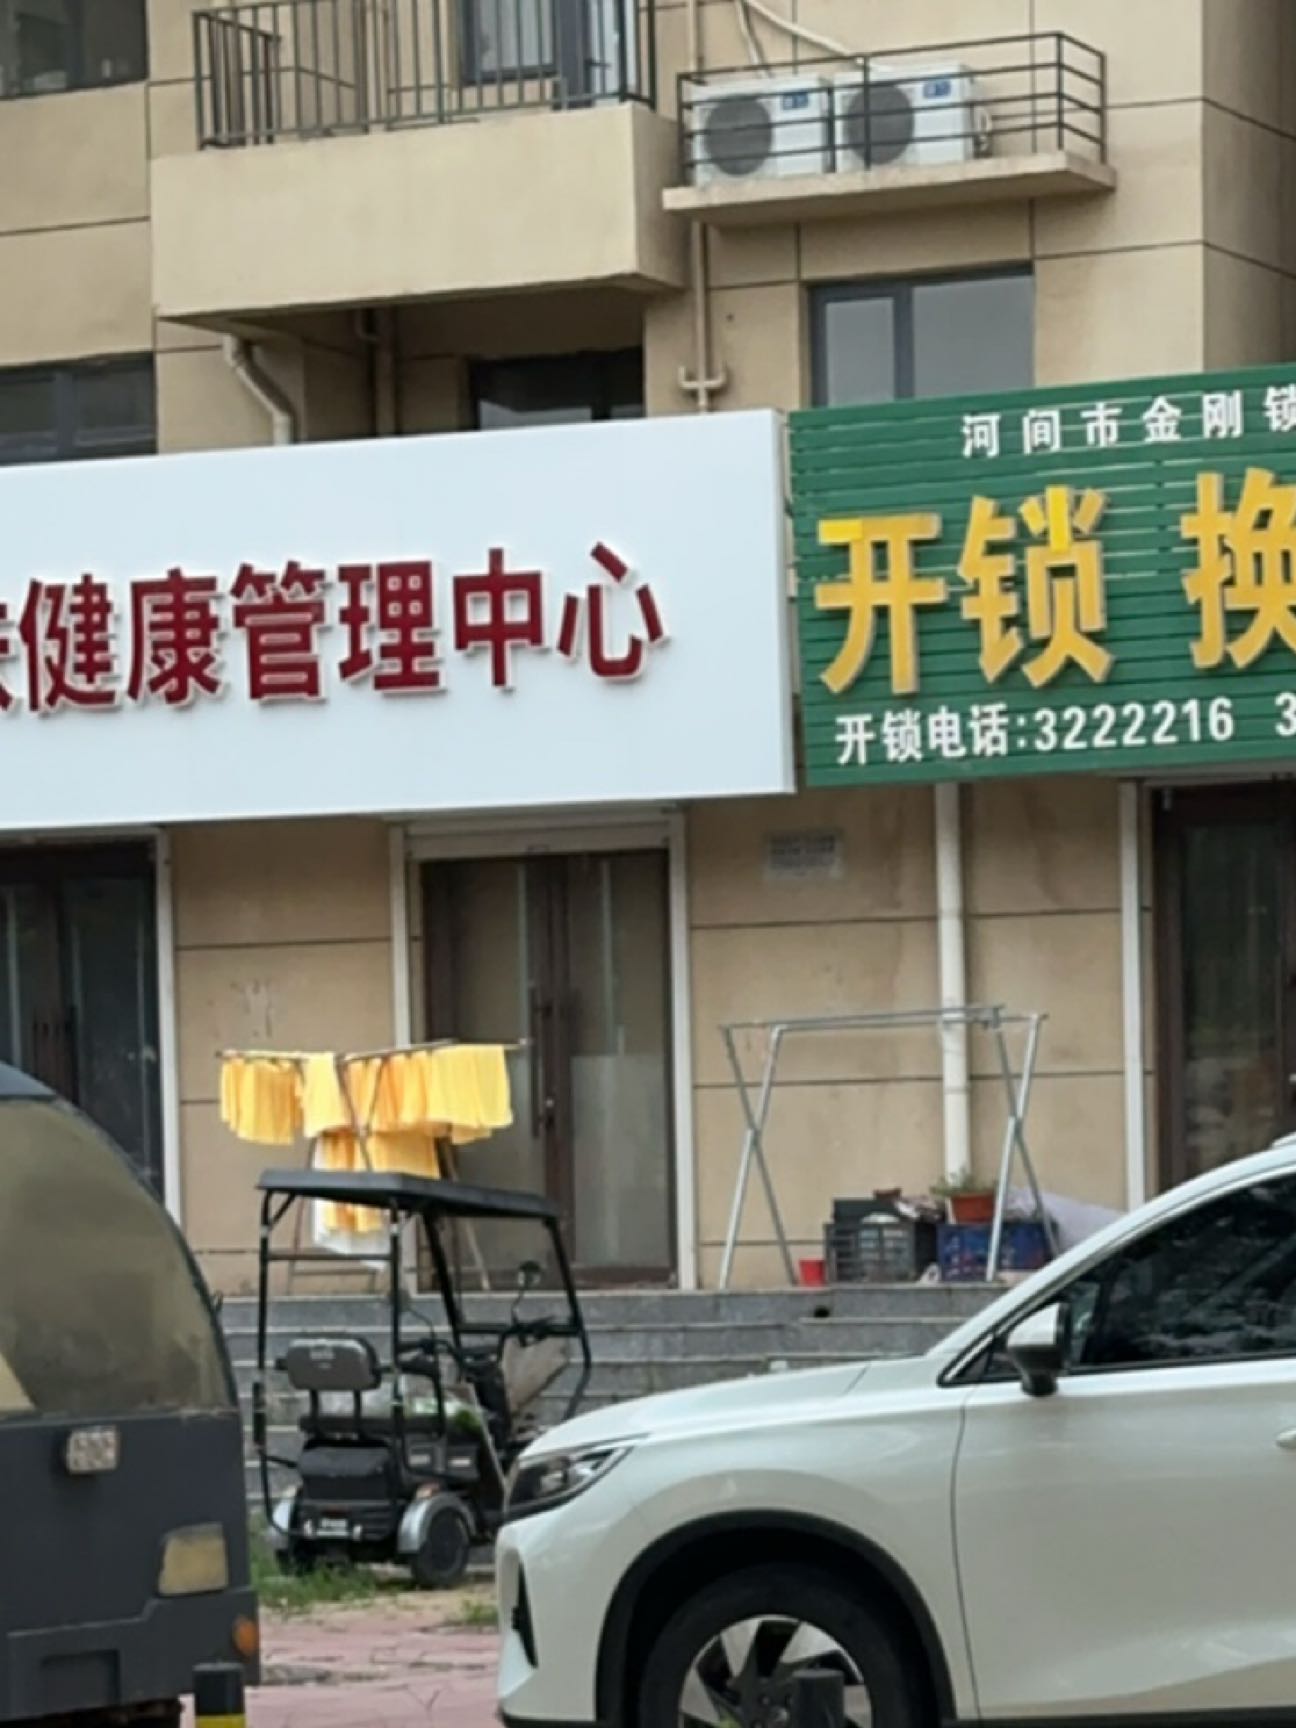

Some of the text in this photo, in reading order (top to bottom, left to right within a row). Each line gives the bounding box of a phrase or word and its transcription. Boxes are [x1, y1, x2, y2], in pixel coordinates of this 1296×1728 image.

[0, 541, 669, 716] 健康管理中心
[814, 484, 1116, 694] 开锁
